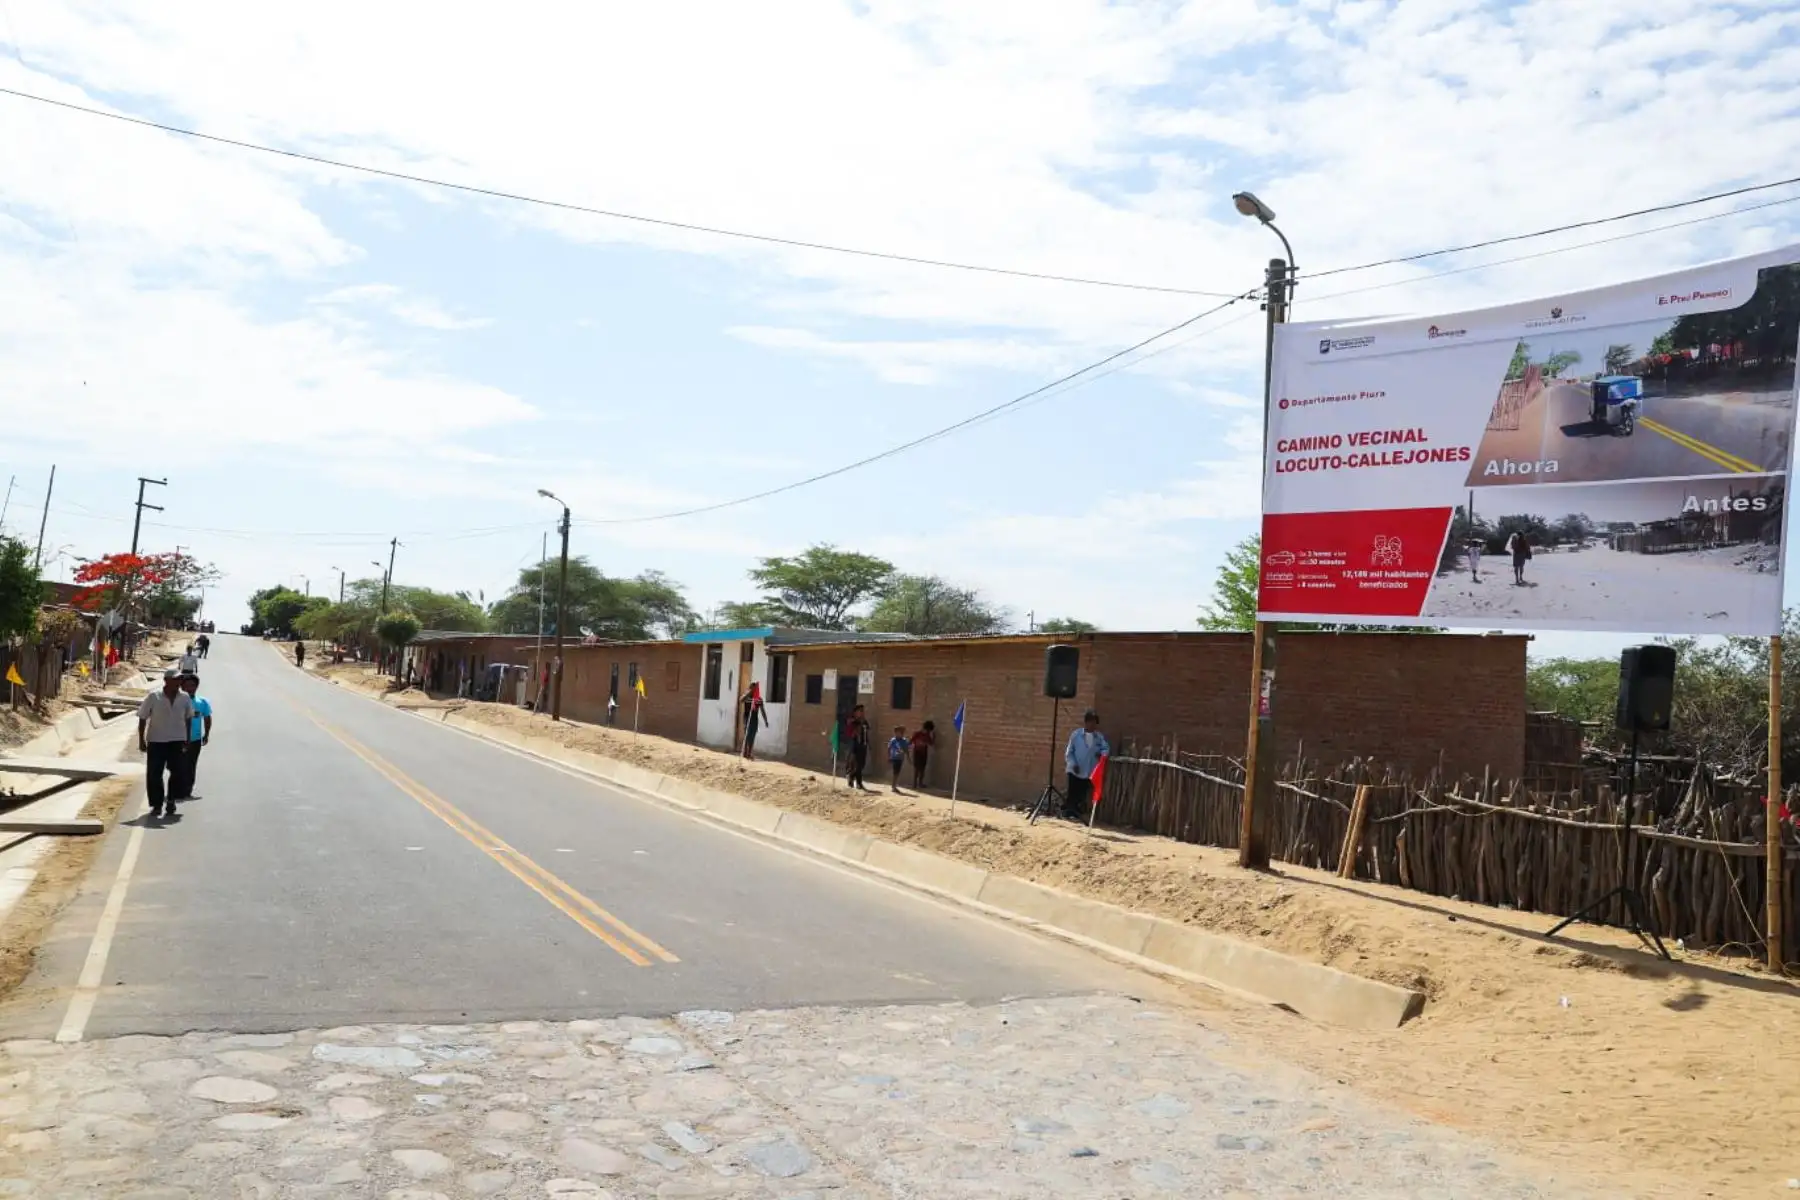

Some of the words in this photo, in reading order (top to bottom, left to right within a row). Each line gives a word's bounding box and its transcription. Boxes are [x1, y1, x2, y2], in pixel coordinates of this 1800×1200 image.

[1291, 394, 1357, 407] Departamento
[1360, 390, 1386, 399] Piura
[1277, 435, 1342, 453] CAMINO
[1347, 428, 1428, 446] VECINAL
[1275, 446, 1471, 473] LOCUTO-CALLEJONES
[1484, 458, 1559, 476] Ahora
[1682, 495, 1768, 513] Antes
[1384, 570, 1429, 578] habitantes
[1359, 580, 1408, 589] beneficiados
